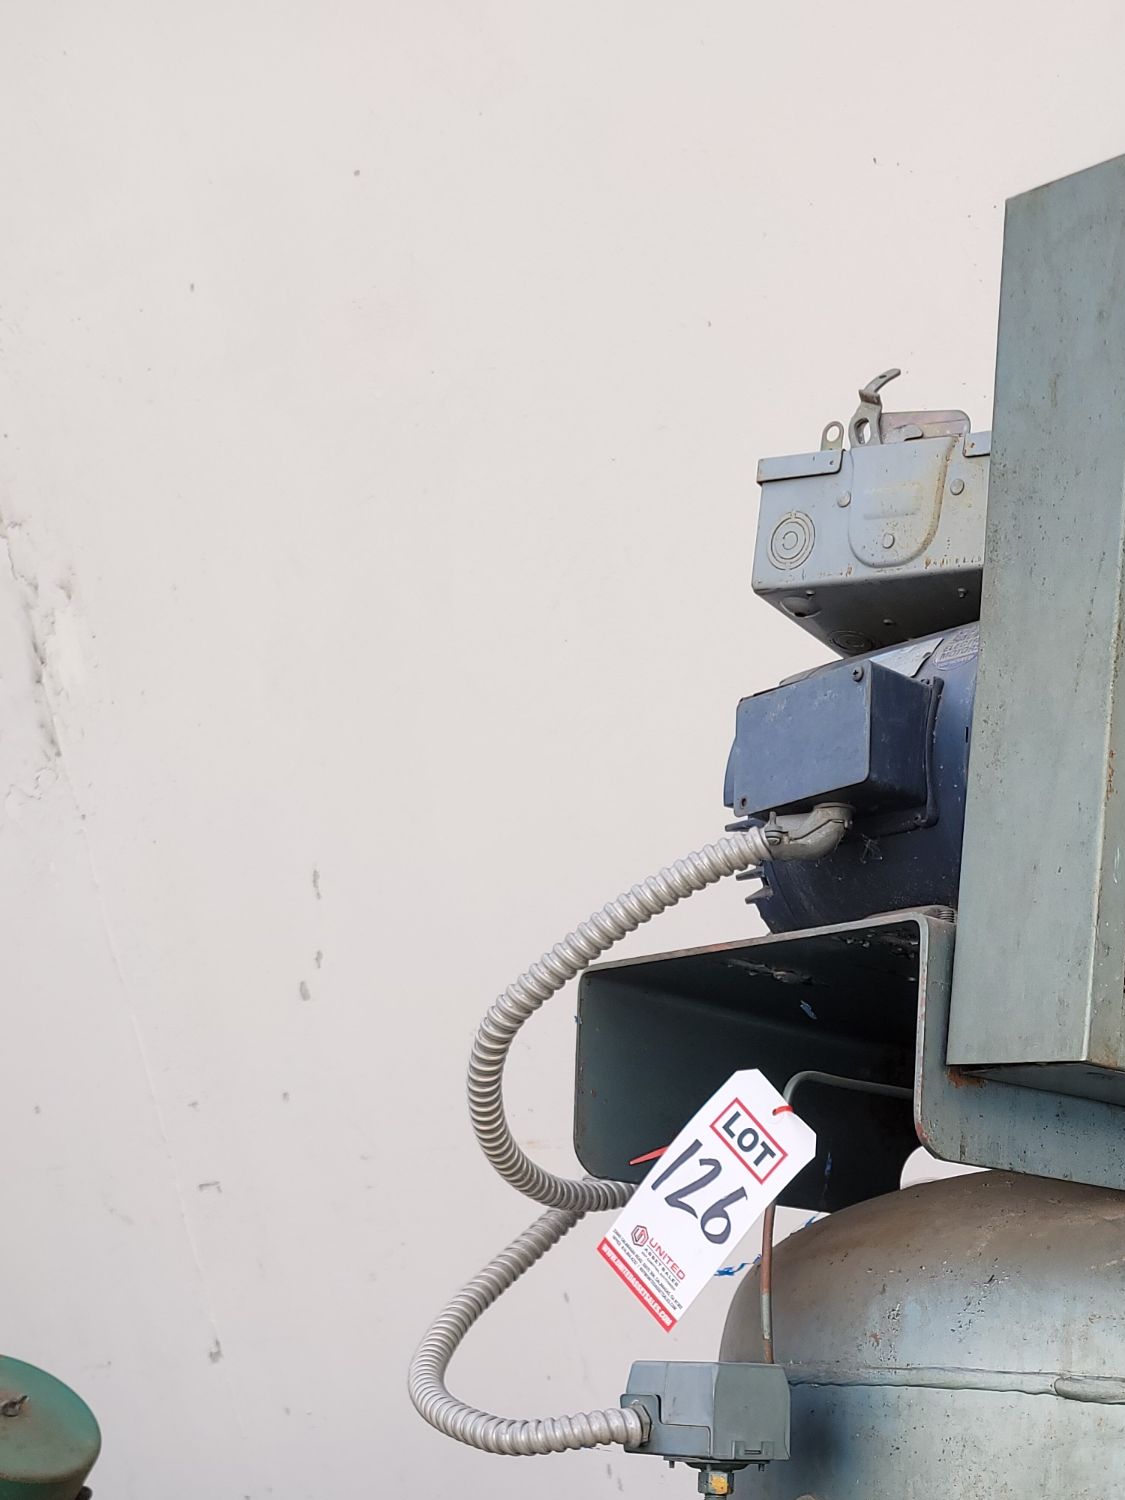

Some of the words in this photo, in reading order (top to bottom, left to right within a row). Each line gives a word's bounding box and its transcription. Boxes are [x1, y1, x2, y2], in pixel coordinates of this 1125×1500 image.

[722, 1111, 776, 1167] LOT
[651, 1139, 748, 1245] 126
[648, 1237, 686, 1281] UNITED
